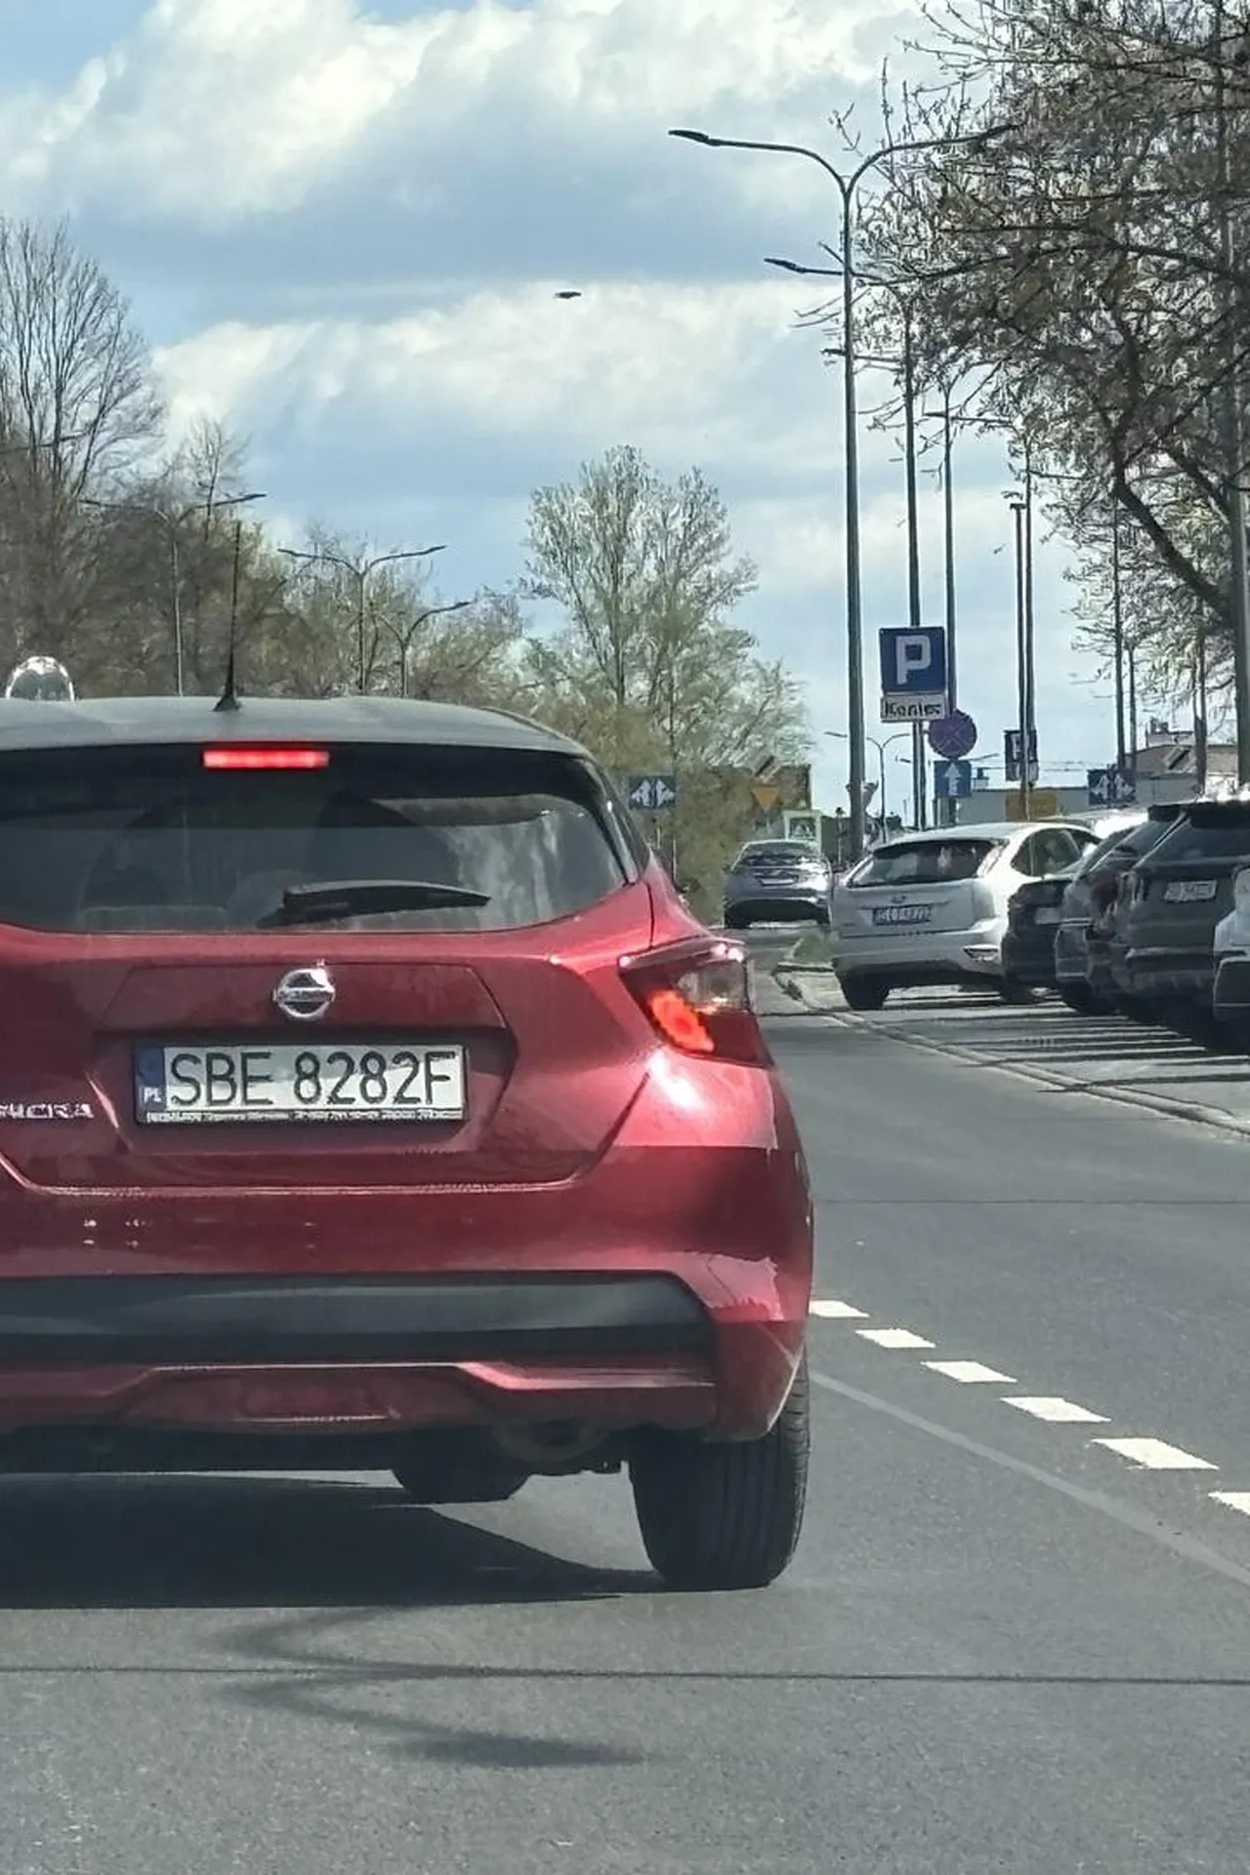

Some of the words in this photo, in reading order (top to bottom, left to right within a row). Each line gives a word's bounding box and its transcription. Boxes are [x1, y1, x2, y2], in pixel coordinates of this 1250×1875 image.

[896, 635, 932, 685] P
[170, 1051, 275, 1106] SBE
[294, 1051, 456, 1105] 8282F
